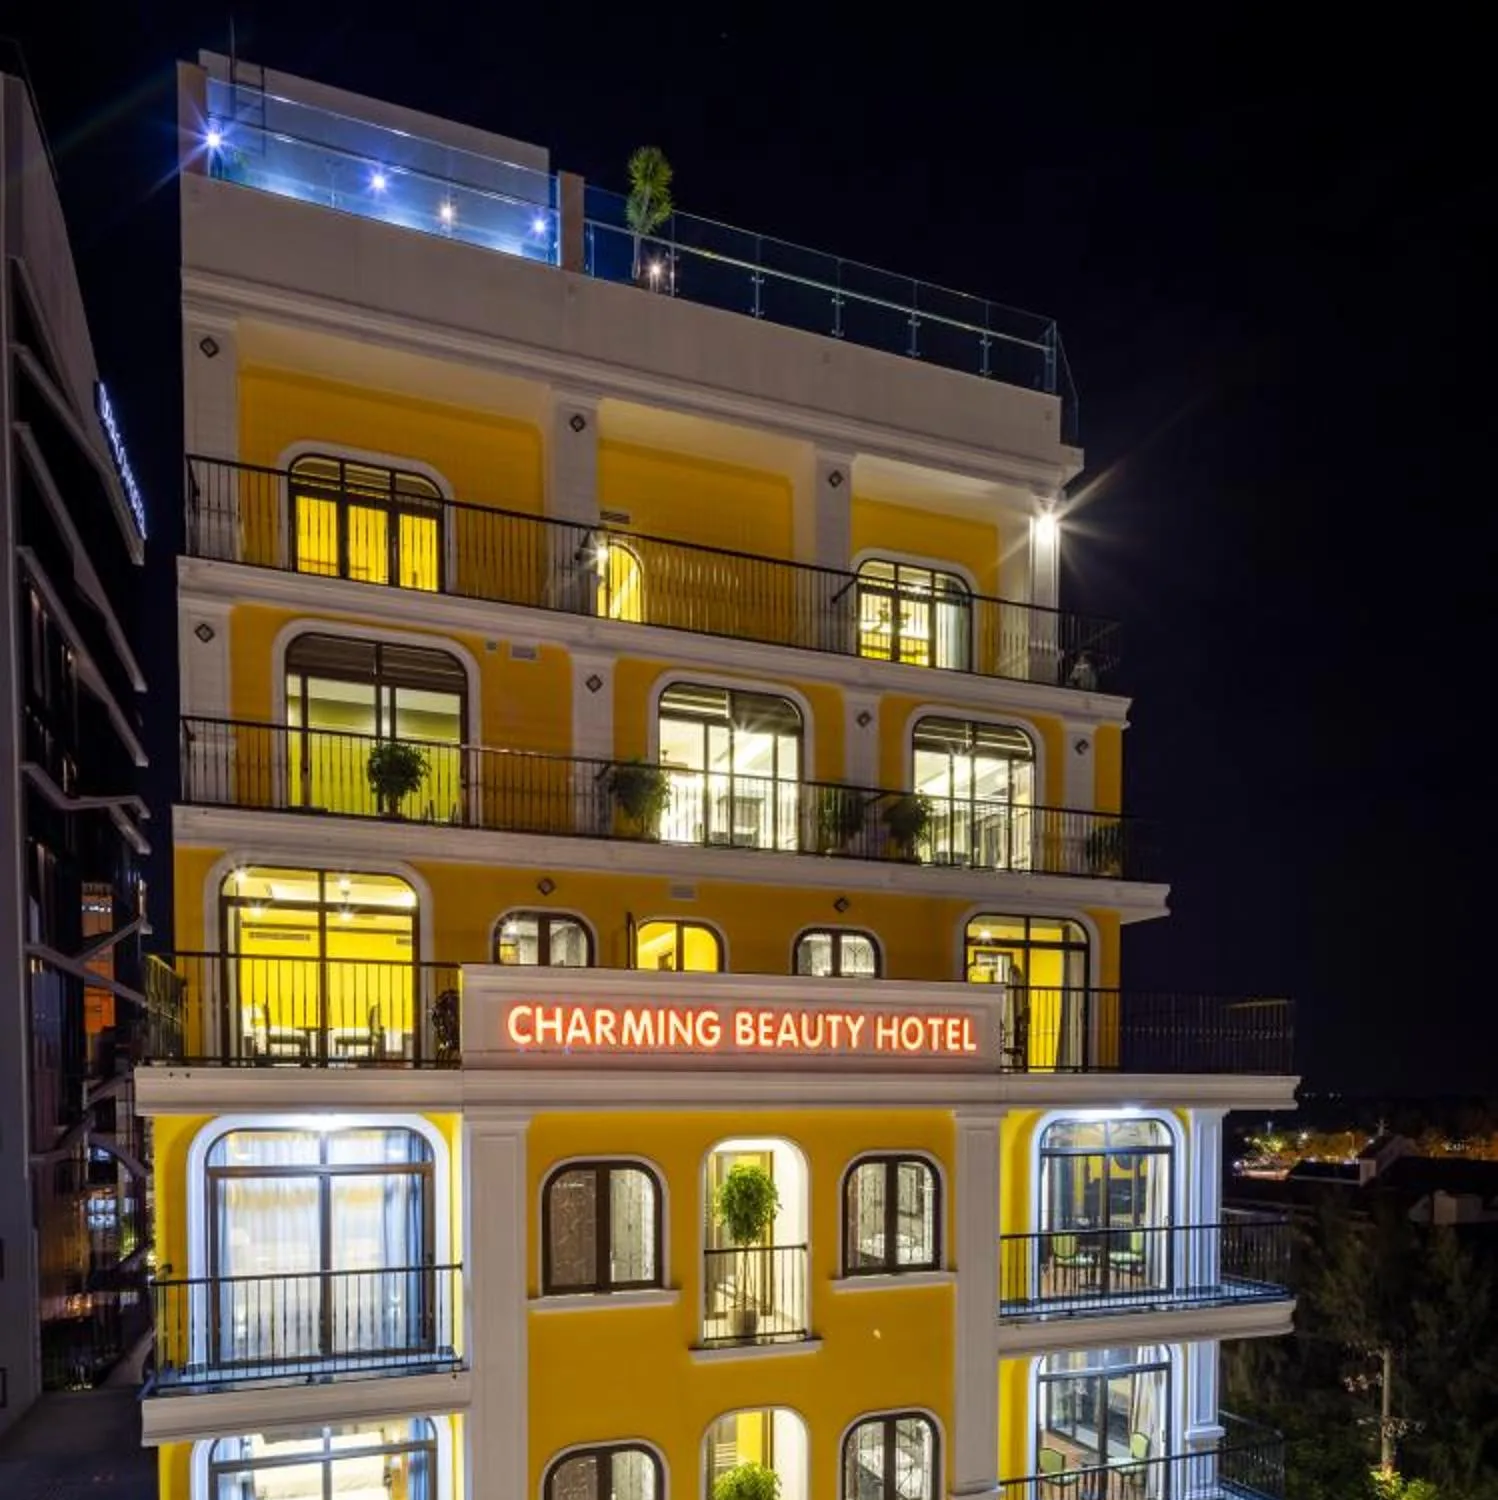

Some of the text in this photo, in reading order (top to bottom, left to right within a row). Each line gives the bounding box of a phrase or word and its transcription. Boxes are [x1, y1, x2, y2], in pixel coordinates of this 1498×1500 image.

[506, 1004, 978, 1052] CHARMING BEAUTY HOTEL
